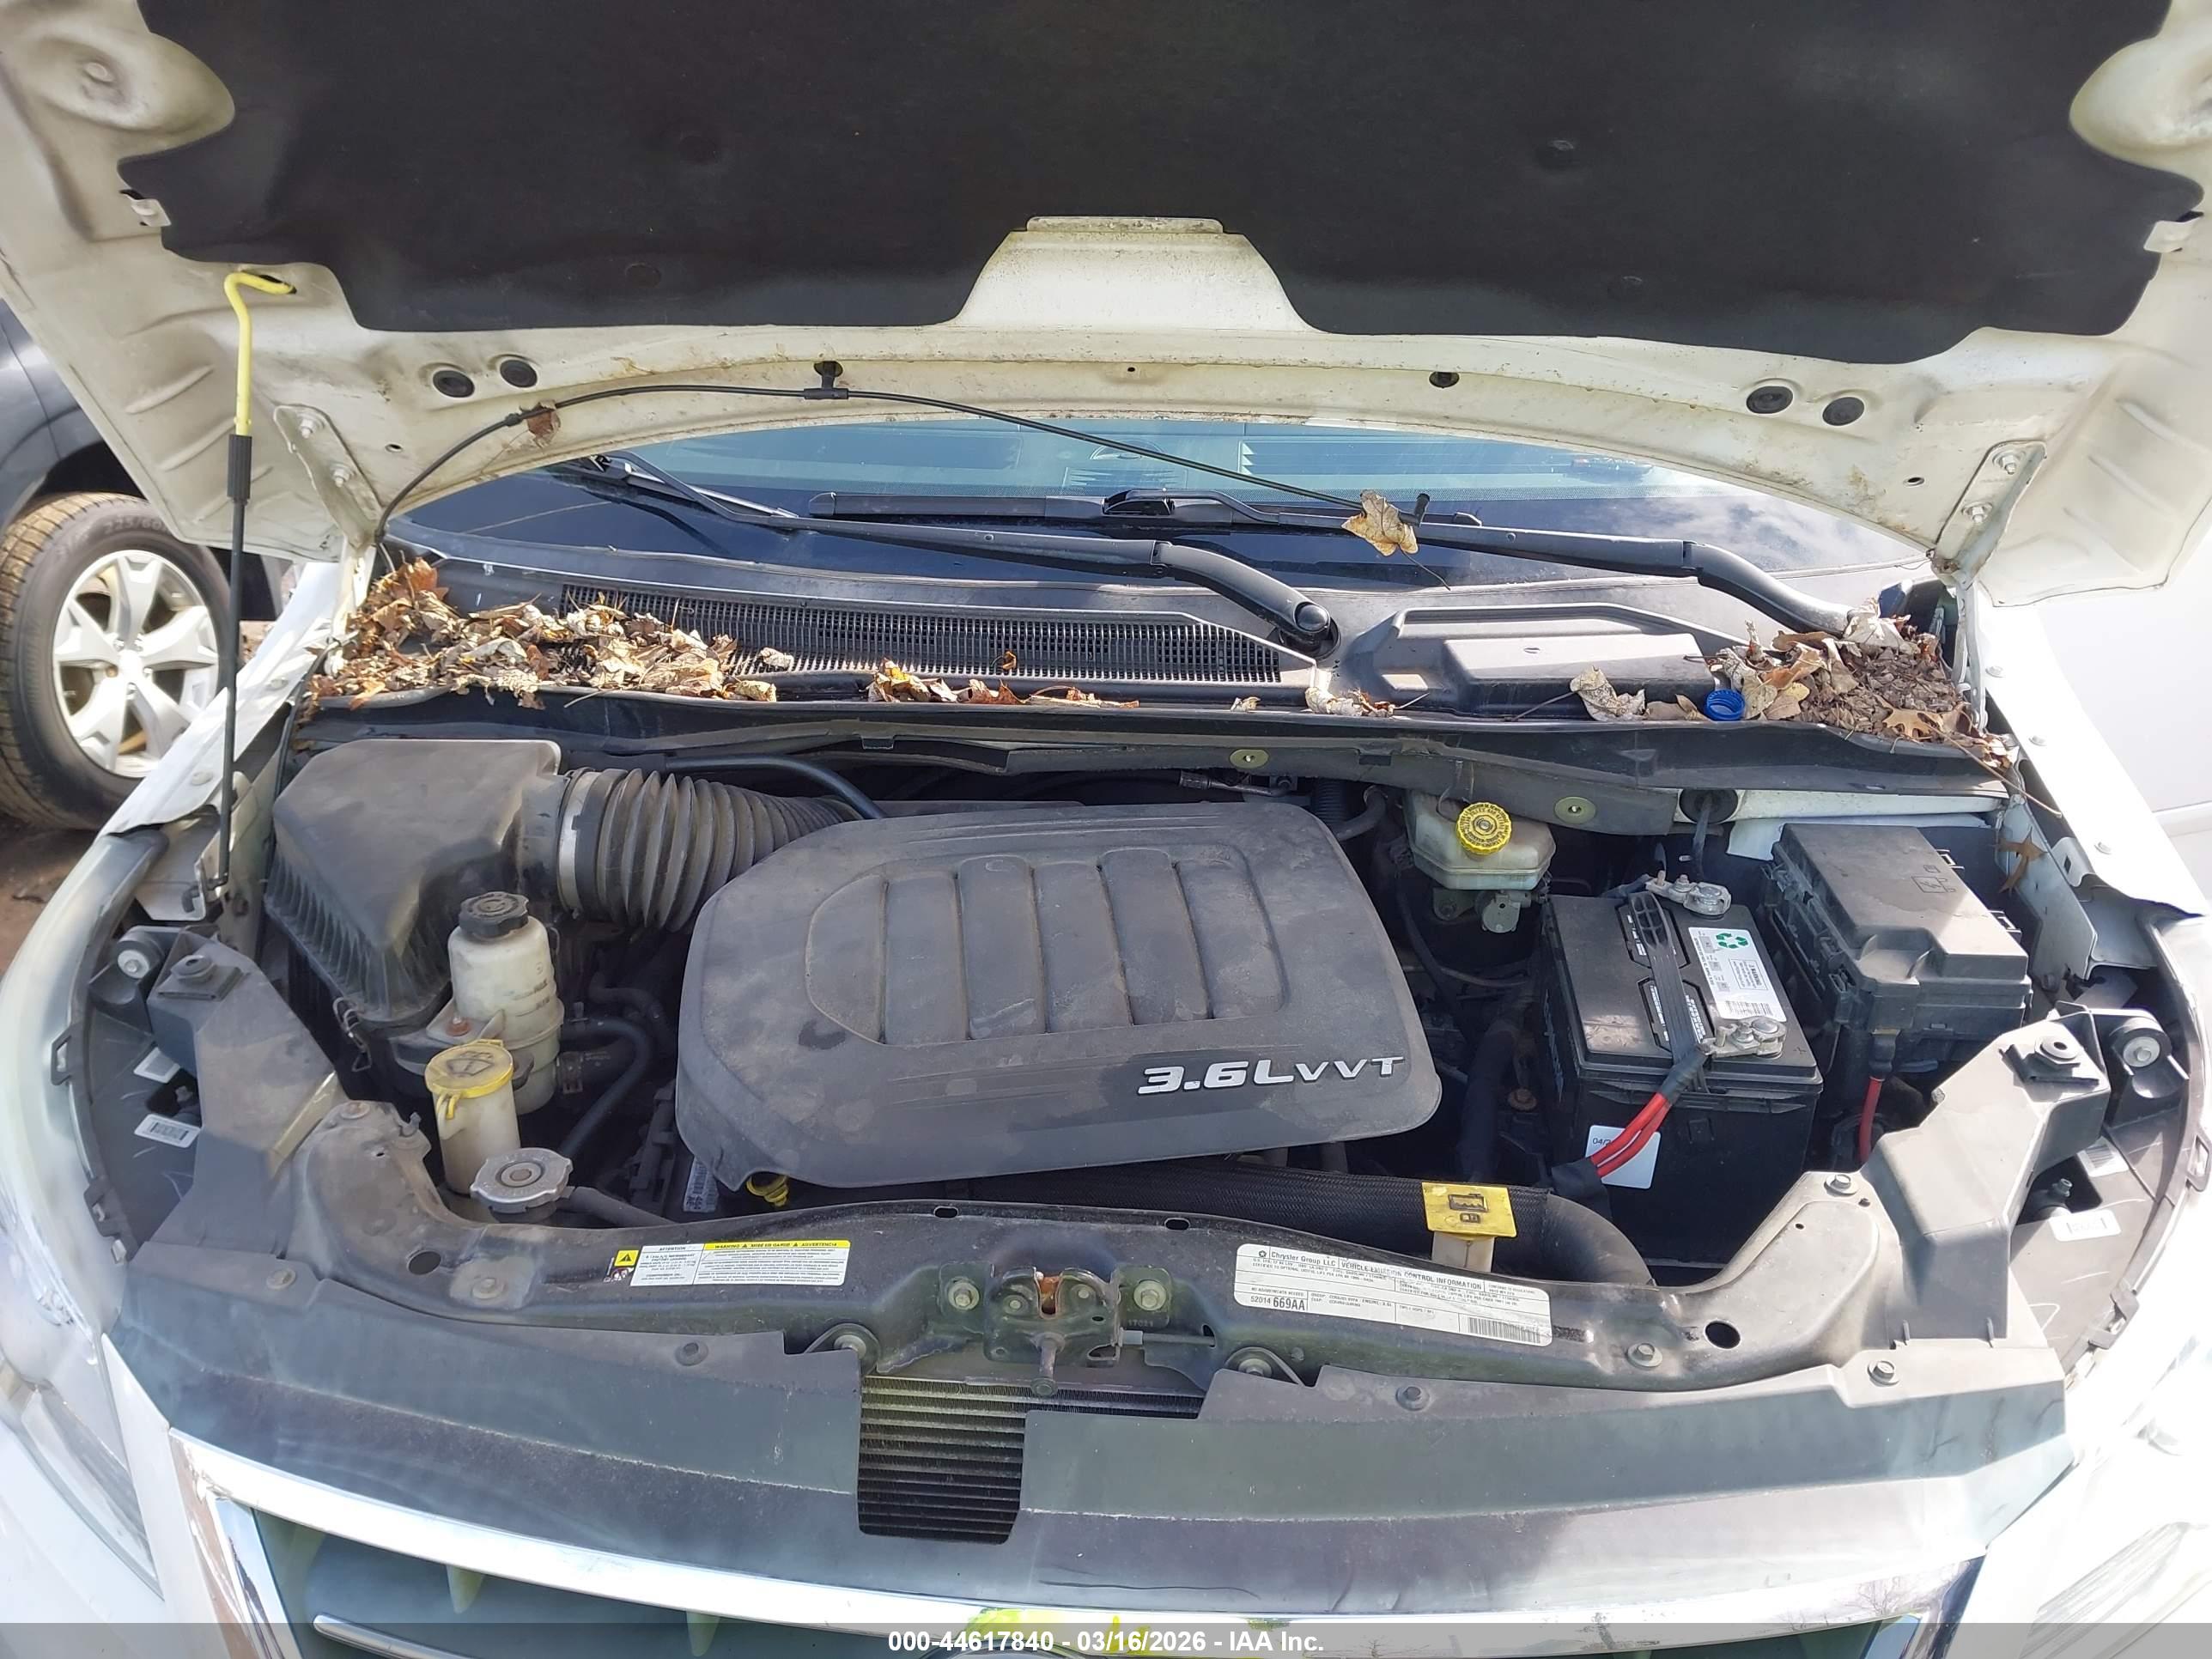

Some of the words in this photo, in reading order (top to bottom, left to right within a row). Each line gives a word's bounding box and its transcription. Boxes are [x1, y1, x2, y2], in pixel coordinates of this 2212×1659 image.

[1271, 1251, 1299, 1262] Chrysler
[1300, 1255, 1321, 1267] Group
[1322, 1258, 1336, 1267] LLC
[1341, 1261, 1369, 1273] VEHICLE
[1404, 1270, 1434, 1282] CONTROL
[1437, 1277, 1483, 1290] INFORMATION
[1250, 1295, 1271, 1305] 52014
[1273, 1297, 1306, 1311] 669AA
